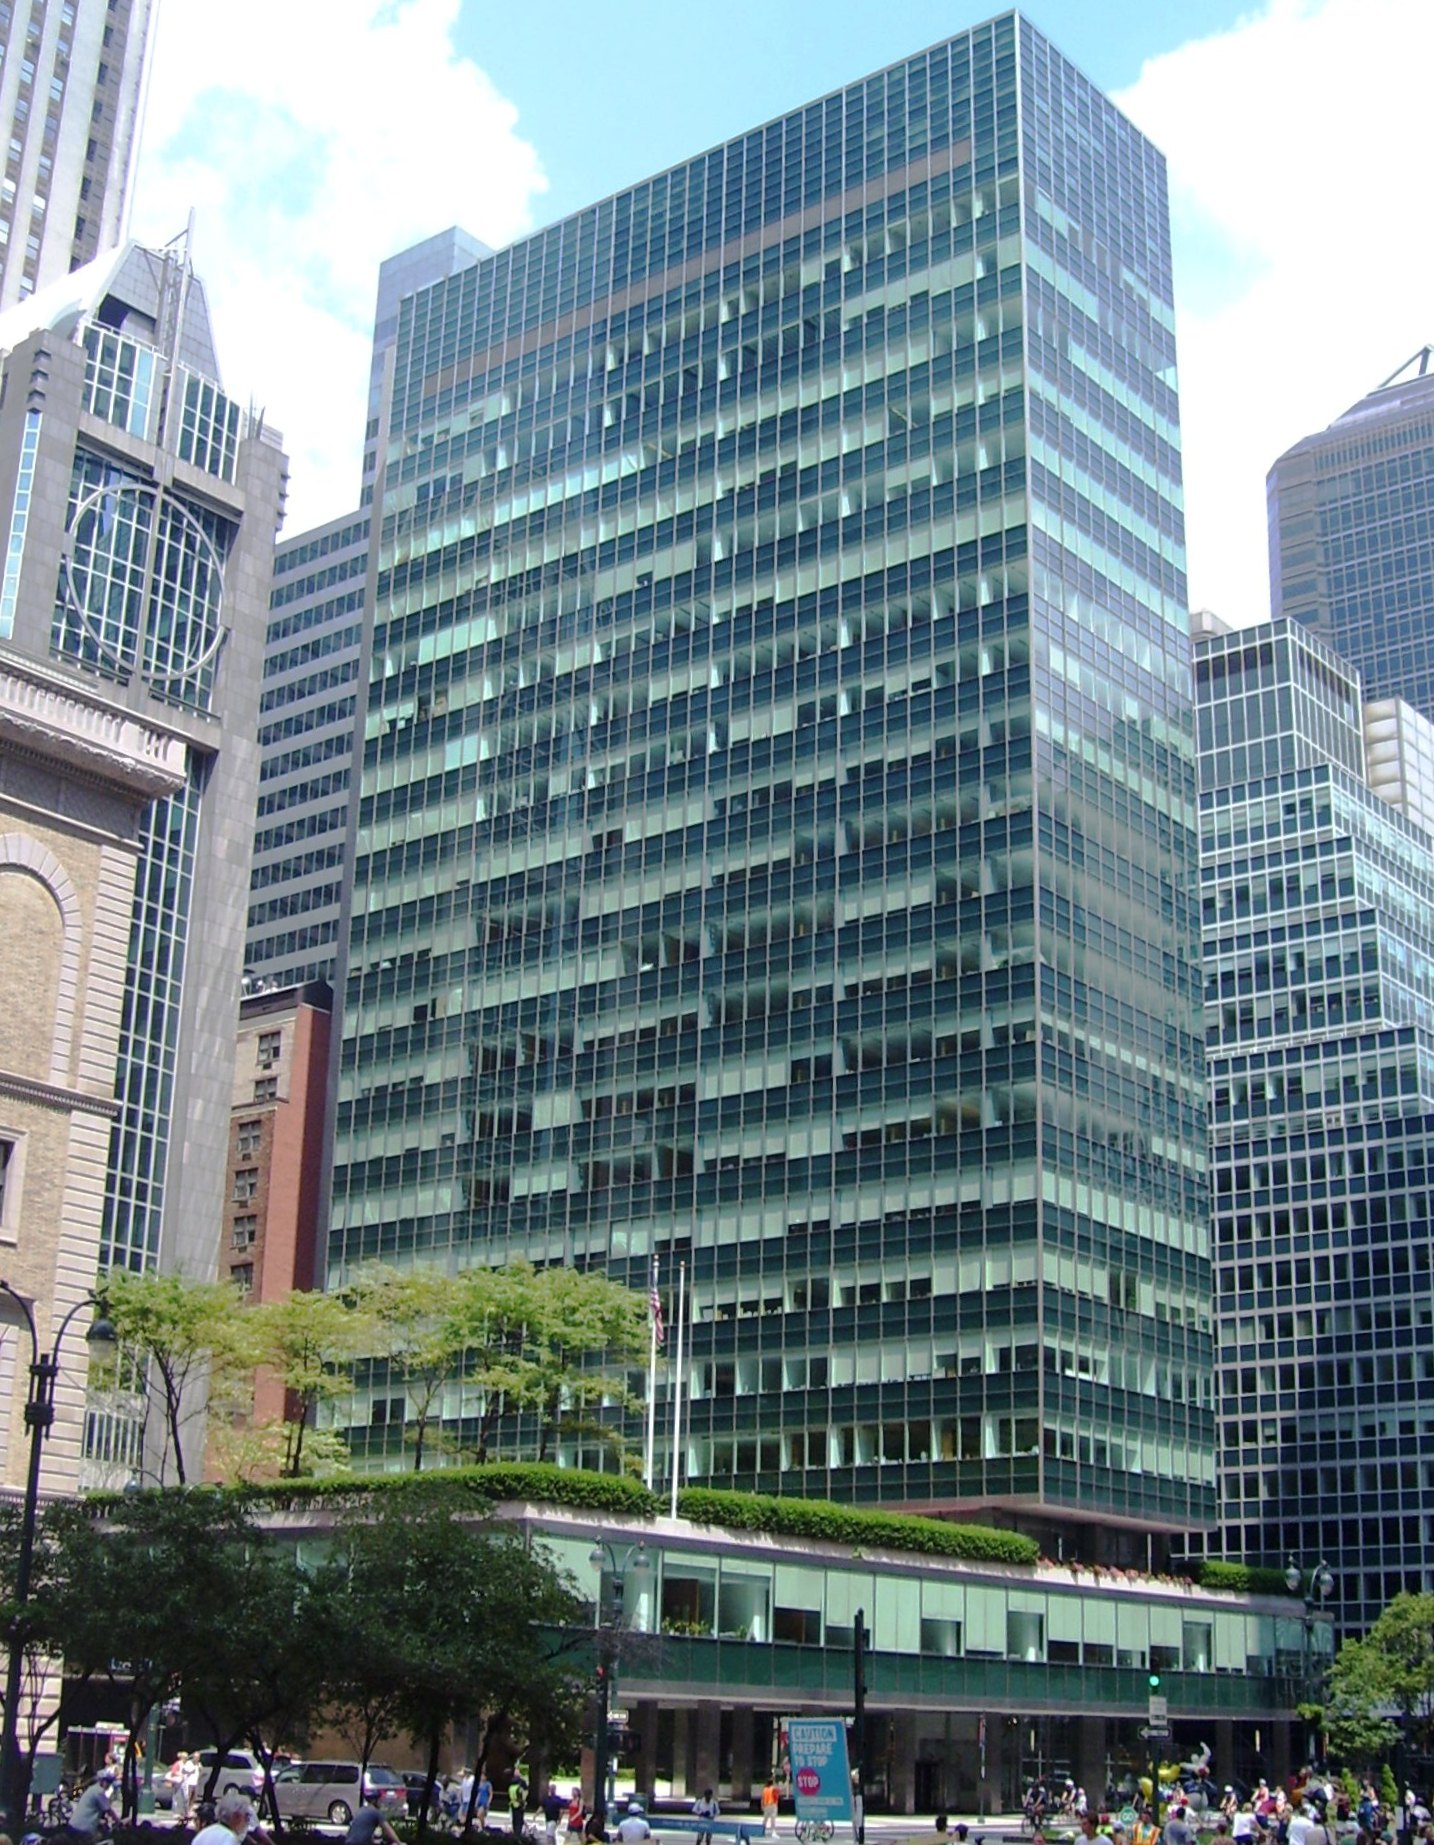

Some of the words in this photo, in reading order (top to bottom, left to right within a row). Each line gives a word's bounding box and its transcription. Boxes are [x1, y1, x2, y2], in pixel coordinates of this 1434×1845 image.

[793, 1727, 834, 1740] CAUTION
[792, 1743, 832, 1755] PREPARE
[795, 1756, 805, 1767] TO
[808, 1756, 828, 1767] STOP
[798, 1776, 819, 1788] STOP
